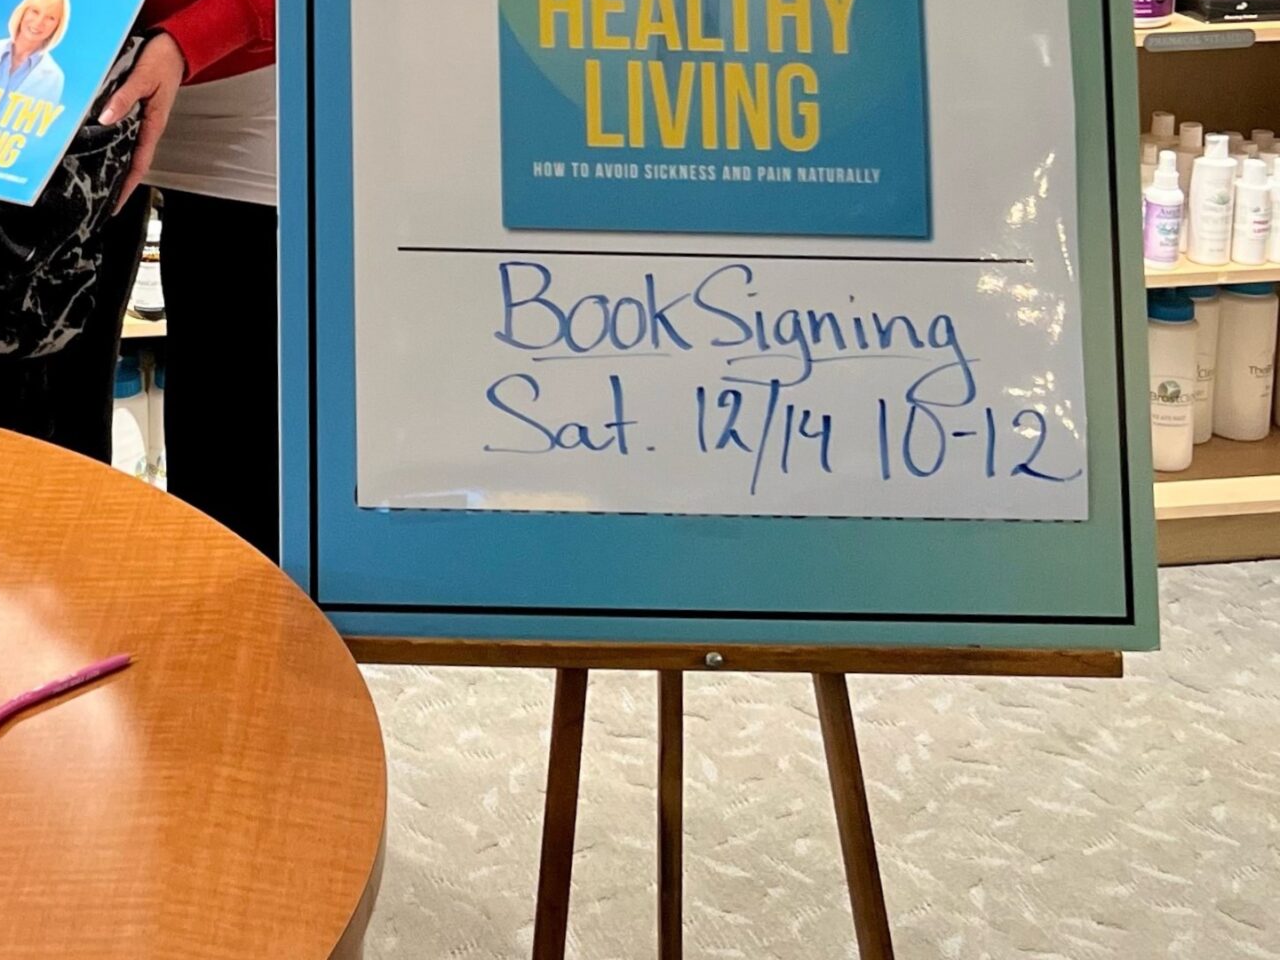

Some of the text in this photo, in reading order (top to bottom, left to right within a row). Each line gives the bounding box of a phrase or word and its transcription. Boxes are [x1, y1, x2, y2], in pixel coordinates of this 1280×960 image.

[584, 59, 821, 153] LIVING
[533, 161, 881, 184] HOW TO AVOID SICKNESS AND PAIN NATURALLY
[483, 373, 1082, 497] Sat. 12/14 10-12
